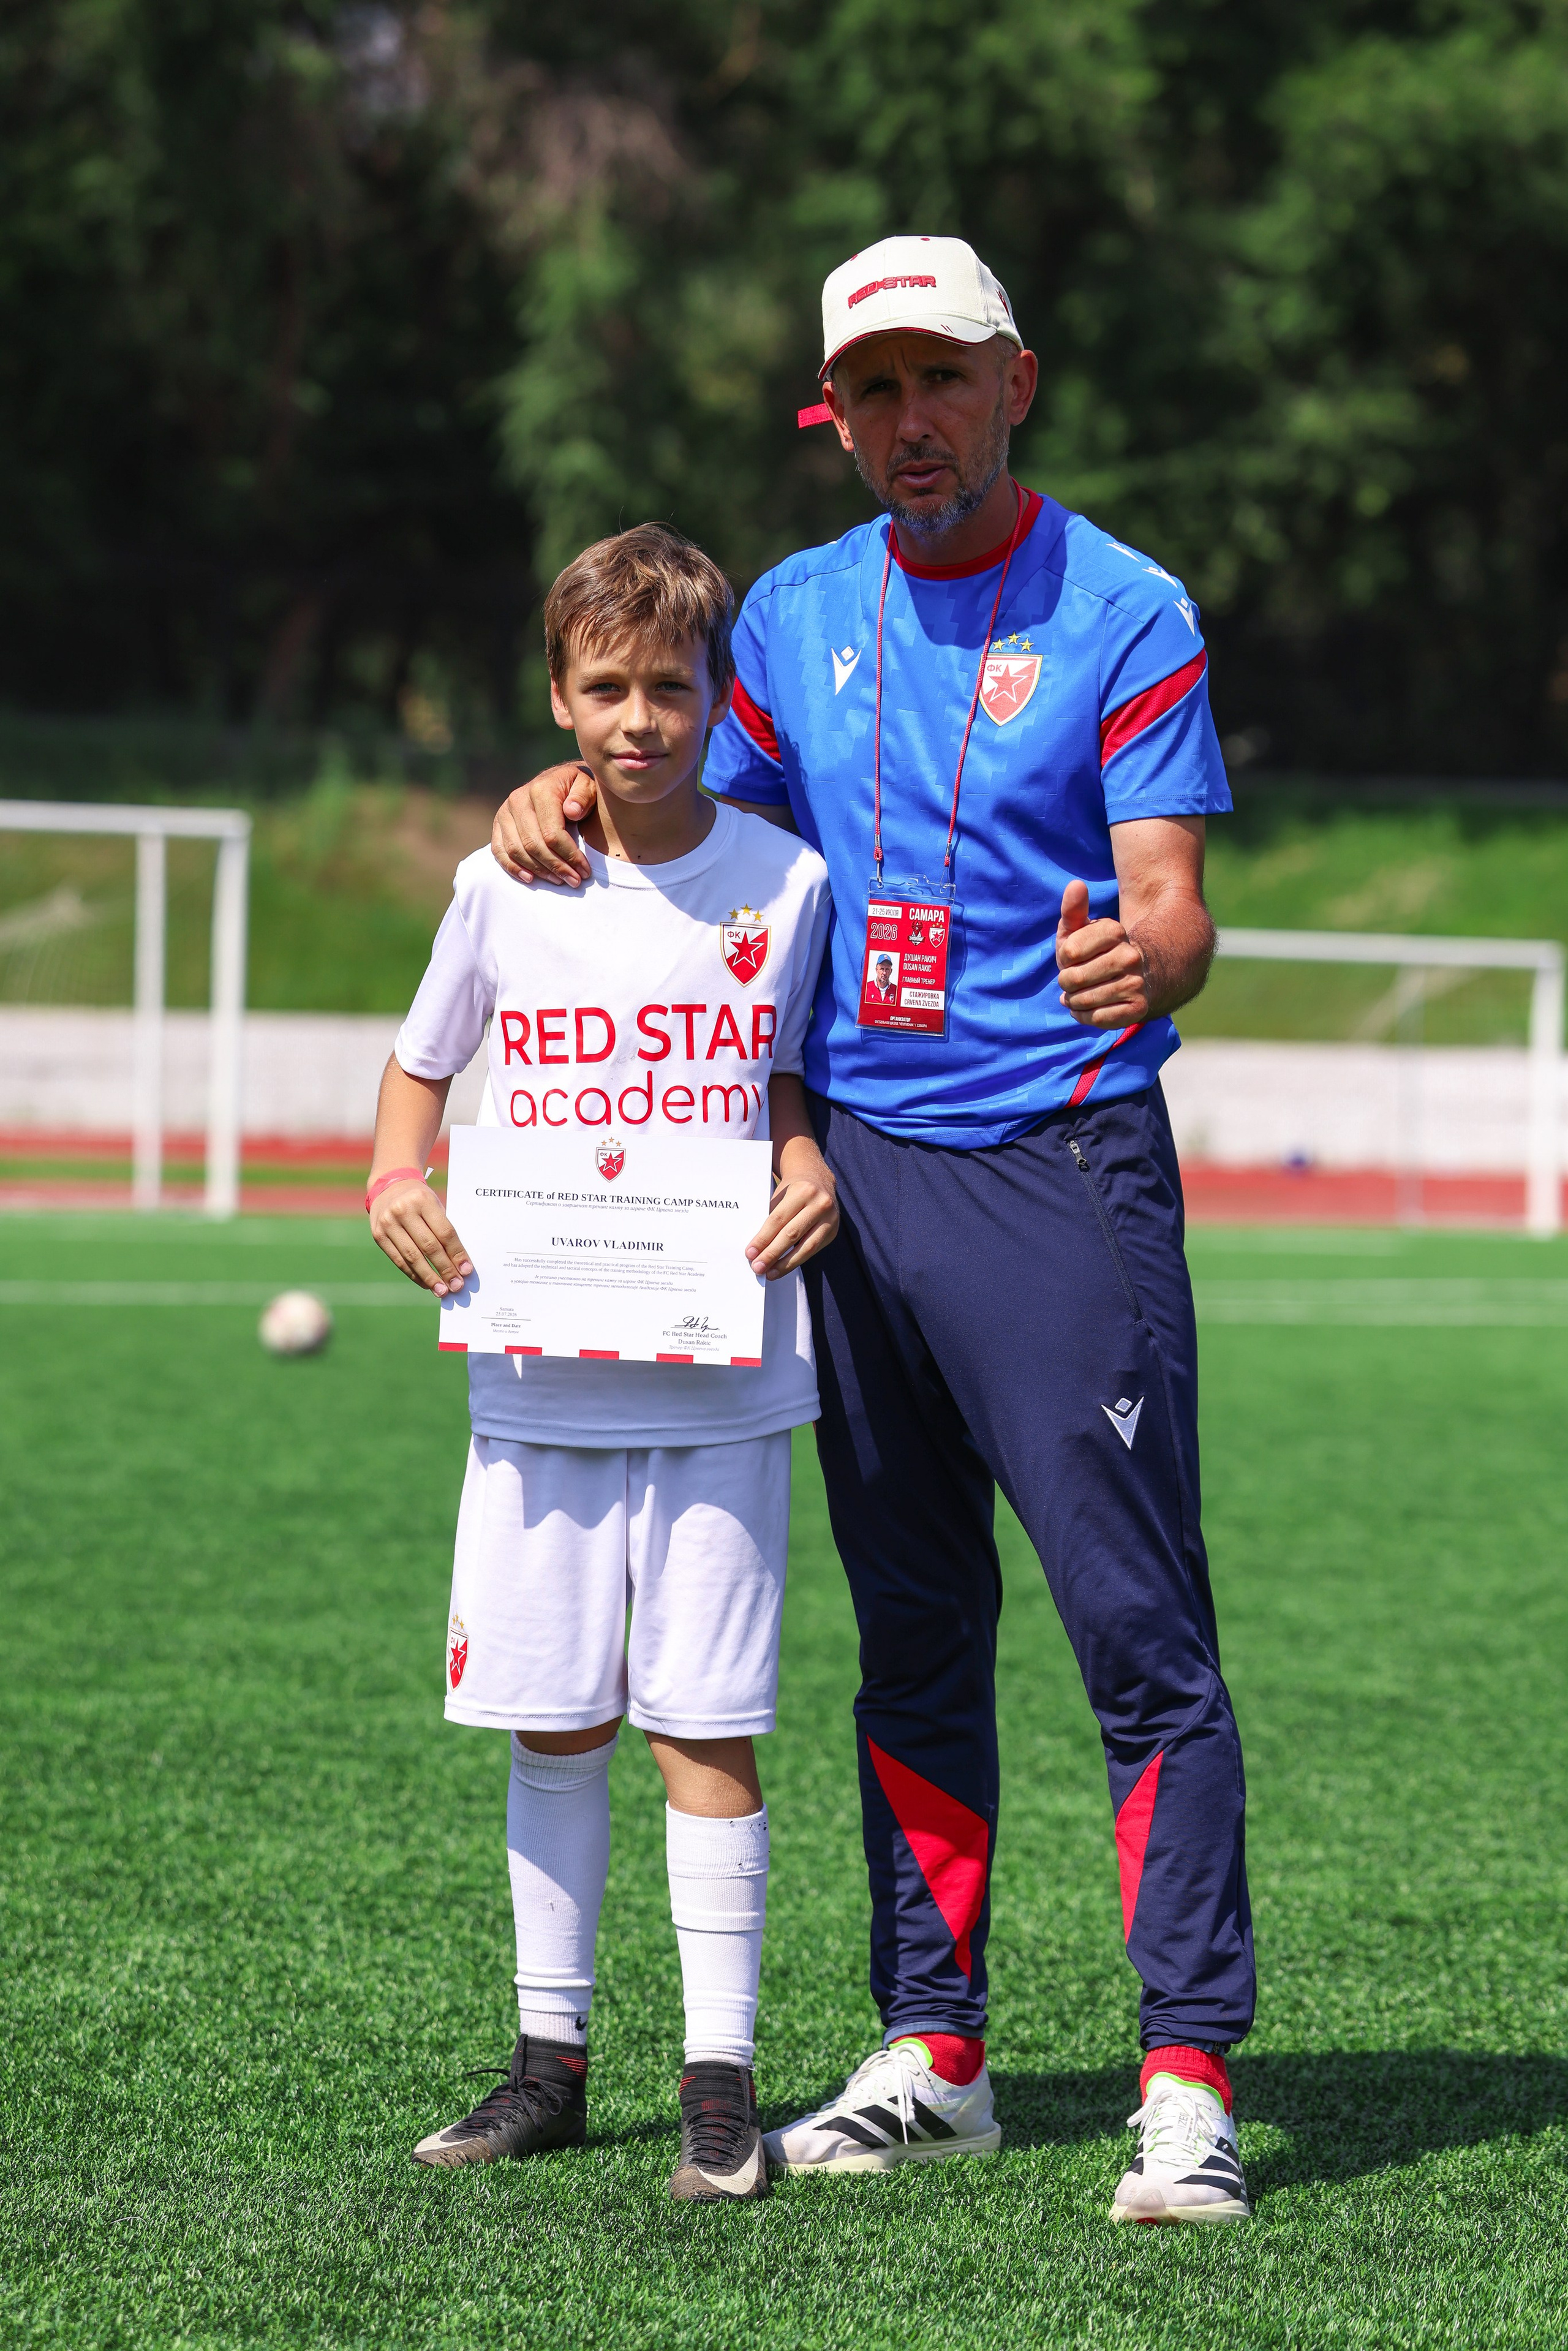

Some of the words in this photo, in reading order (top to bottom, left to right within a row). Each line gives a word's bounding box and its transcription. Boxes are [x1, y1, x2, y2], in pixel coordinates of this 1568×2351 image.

[987, 663, 1002, 673] ФК
[909, 908, 944, 923] САМАРА
[727, 930, 741, 939] ФК
[870, 923, 898, 941] 2026
[904, 953, 921, 962] ДУШАН
[500, 1007, 616, 1065] RED
[636, 1004, 777, 1062] STAR
[475, 1188, 544, 1199] CERTIFICATE
[557, 1192, 579, 1201] RED
[581, 1194, 607, 1202] STAR
[609, 1195, 661, 1205] TRAINING
[664, 1198, 693, 1207] CAMP
[695, 1199, 739, 1209] SAMARA
[552, 1237, 600, 1248] UVAROV
[603, 1240, 664, 1251] VLADIMIR
